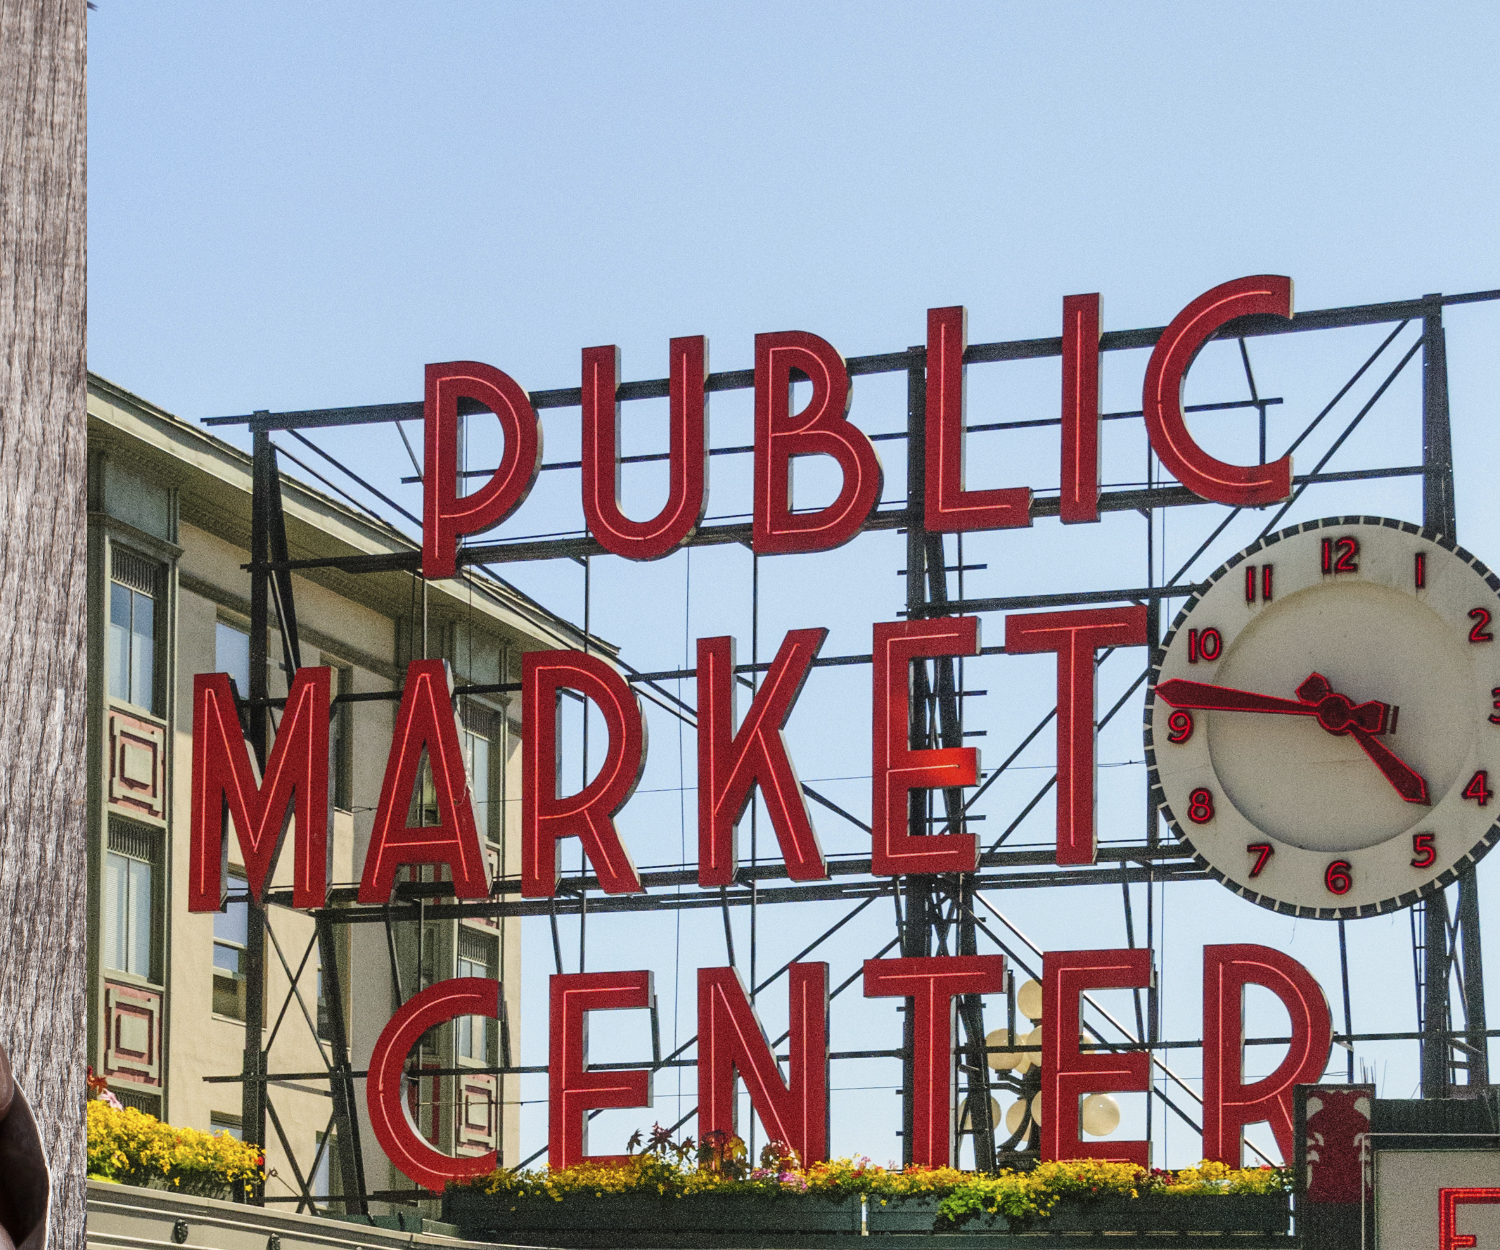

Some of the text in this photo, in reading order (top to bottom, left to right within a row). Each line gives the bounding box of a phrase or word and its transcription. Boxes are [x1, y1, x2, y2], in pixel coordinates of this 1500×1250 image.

[422, 274, 1294, 580] PUBLIC
[1320, 535, 1360, 575] 12
[1414, 552, 1426, 589] 1
[1244, 564, 1274, 604] 11
[1468, 607, 1494, 644] 2
[1187, 627, 1223, 664] 10
[1167, 710, 1194, 744] 9
[188, 605, 1149, 914] MARKET
[1187, 787, 1216, 825] 8
[1461, 770, 1494, 807] 4
[1246, 843, 1275, 879] 7
[1410, 833, 1437, 868] 5
[1324, 860, 1353, 896] 6
[367, 943, 1334, 1196] CENTER
